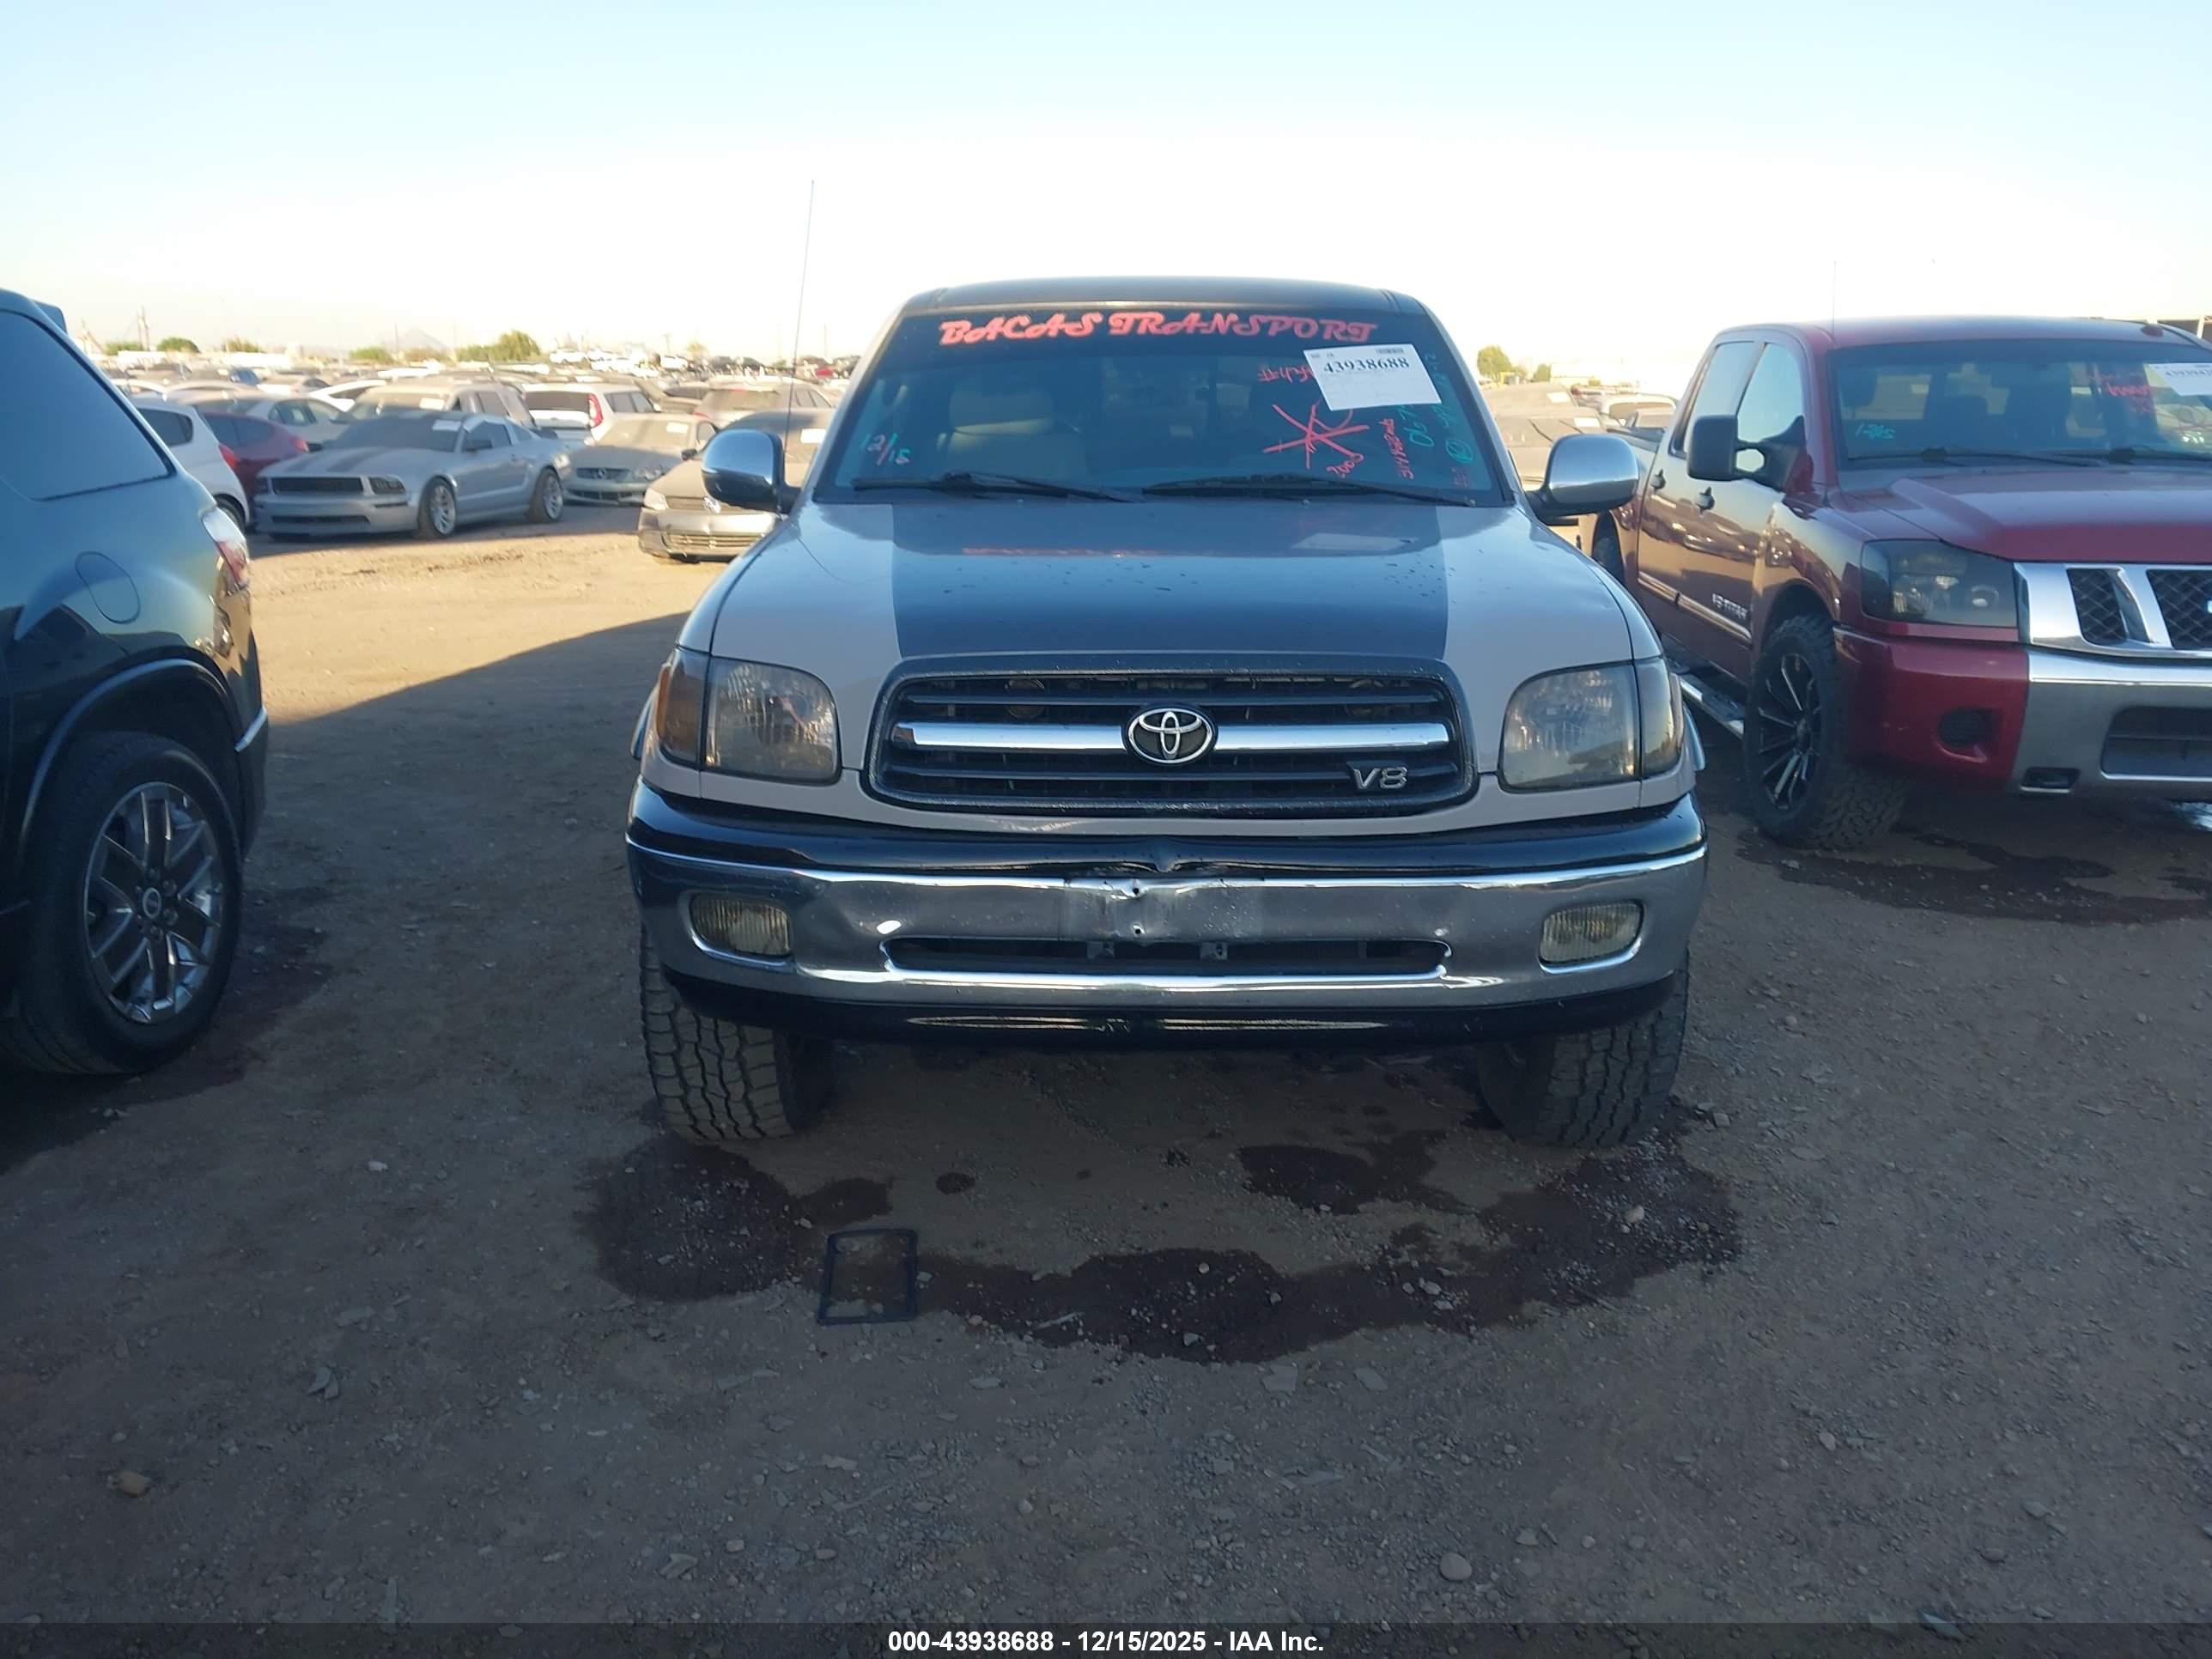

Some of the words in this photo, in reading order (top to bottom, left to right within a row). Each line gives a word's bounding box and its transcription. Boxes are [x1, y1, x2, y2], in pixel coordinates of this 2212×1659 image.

[939, 312, 1103, 345] BACAS
[1109, 311, 1377, 343] TRANSPORT
[1323, 356, 1410, 374] 43938688
[1352, 766, 1408, 790] V8
